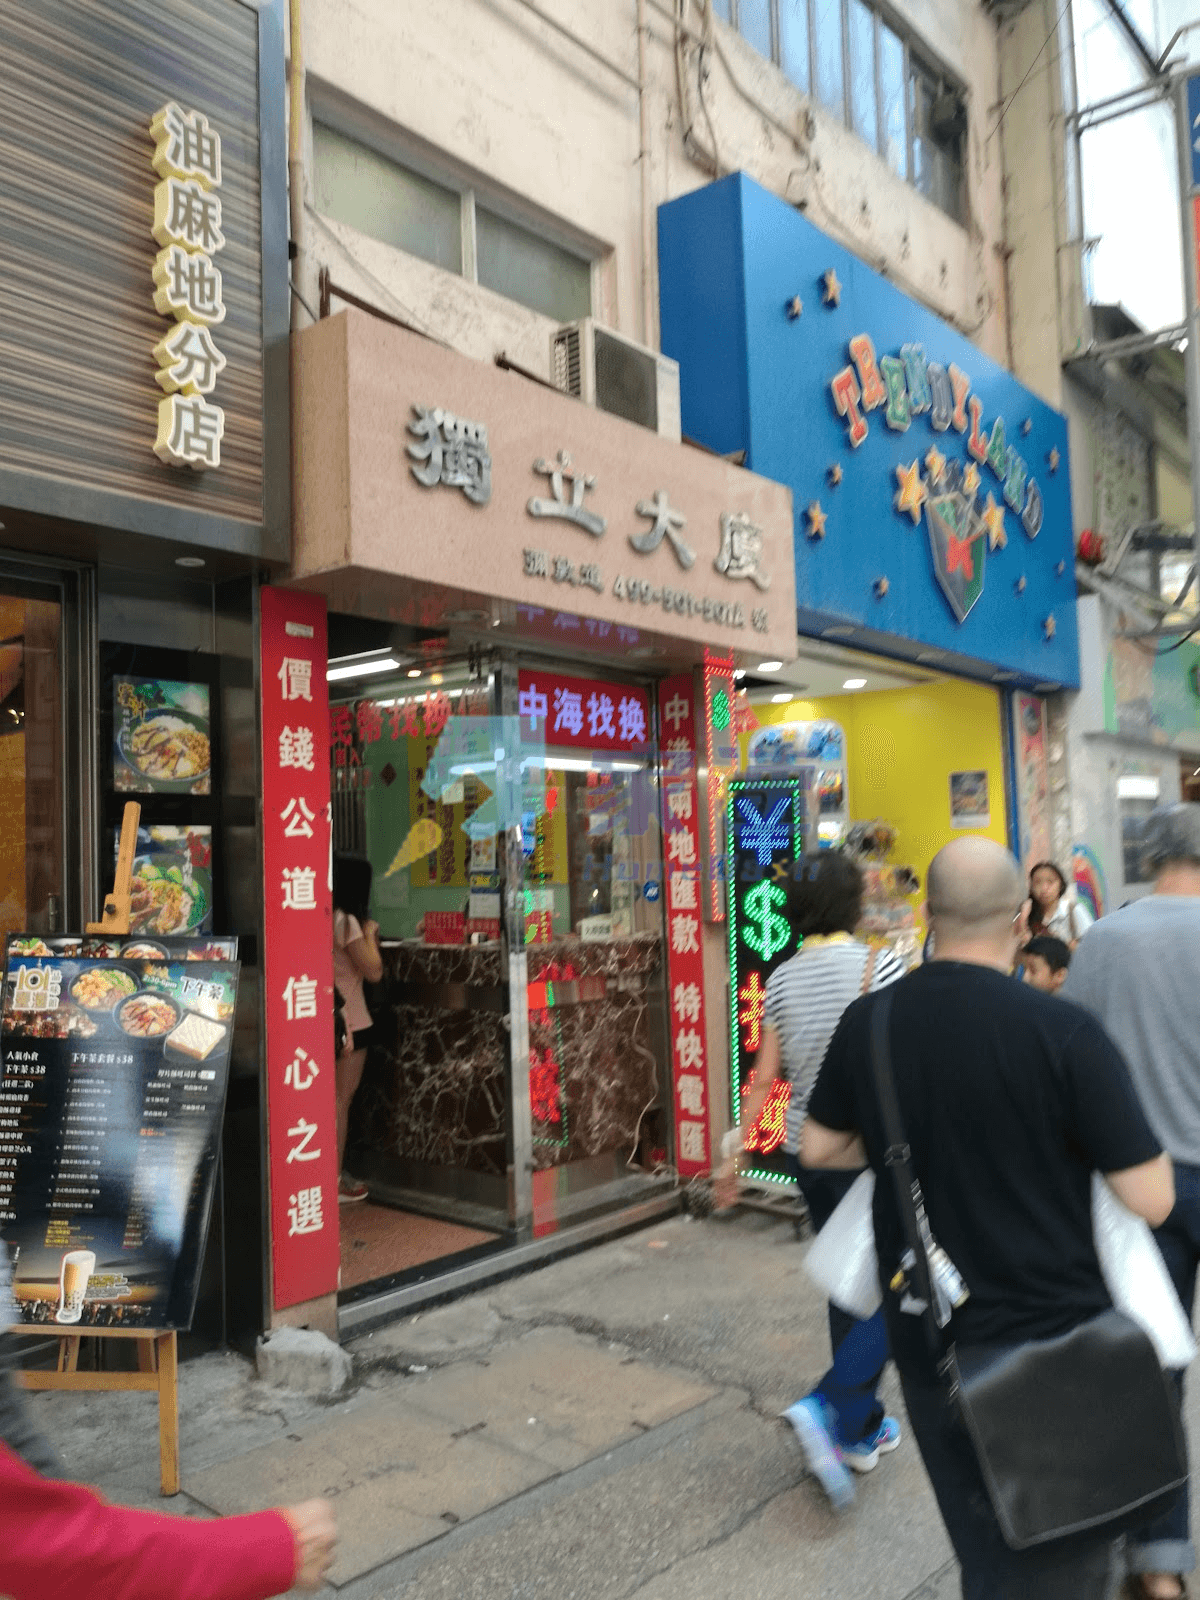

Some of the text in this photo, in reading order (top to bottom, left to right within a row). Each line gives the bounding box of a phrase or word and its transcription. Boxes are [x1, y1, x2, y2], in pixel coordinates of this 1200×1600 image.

[150, 102, 226, 468] 油麻地分店
[405, 402, 772, 592] 獨立大廈
[180, 975, 225, 1001] 下午茶
[282, 973, 324, 1237] 信心之選
